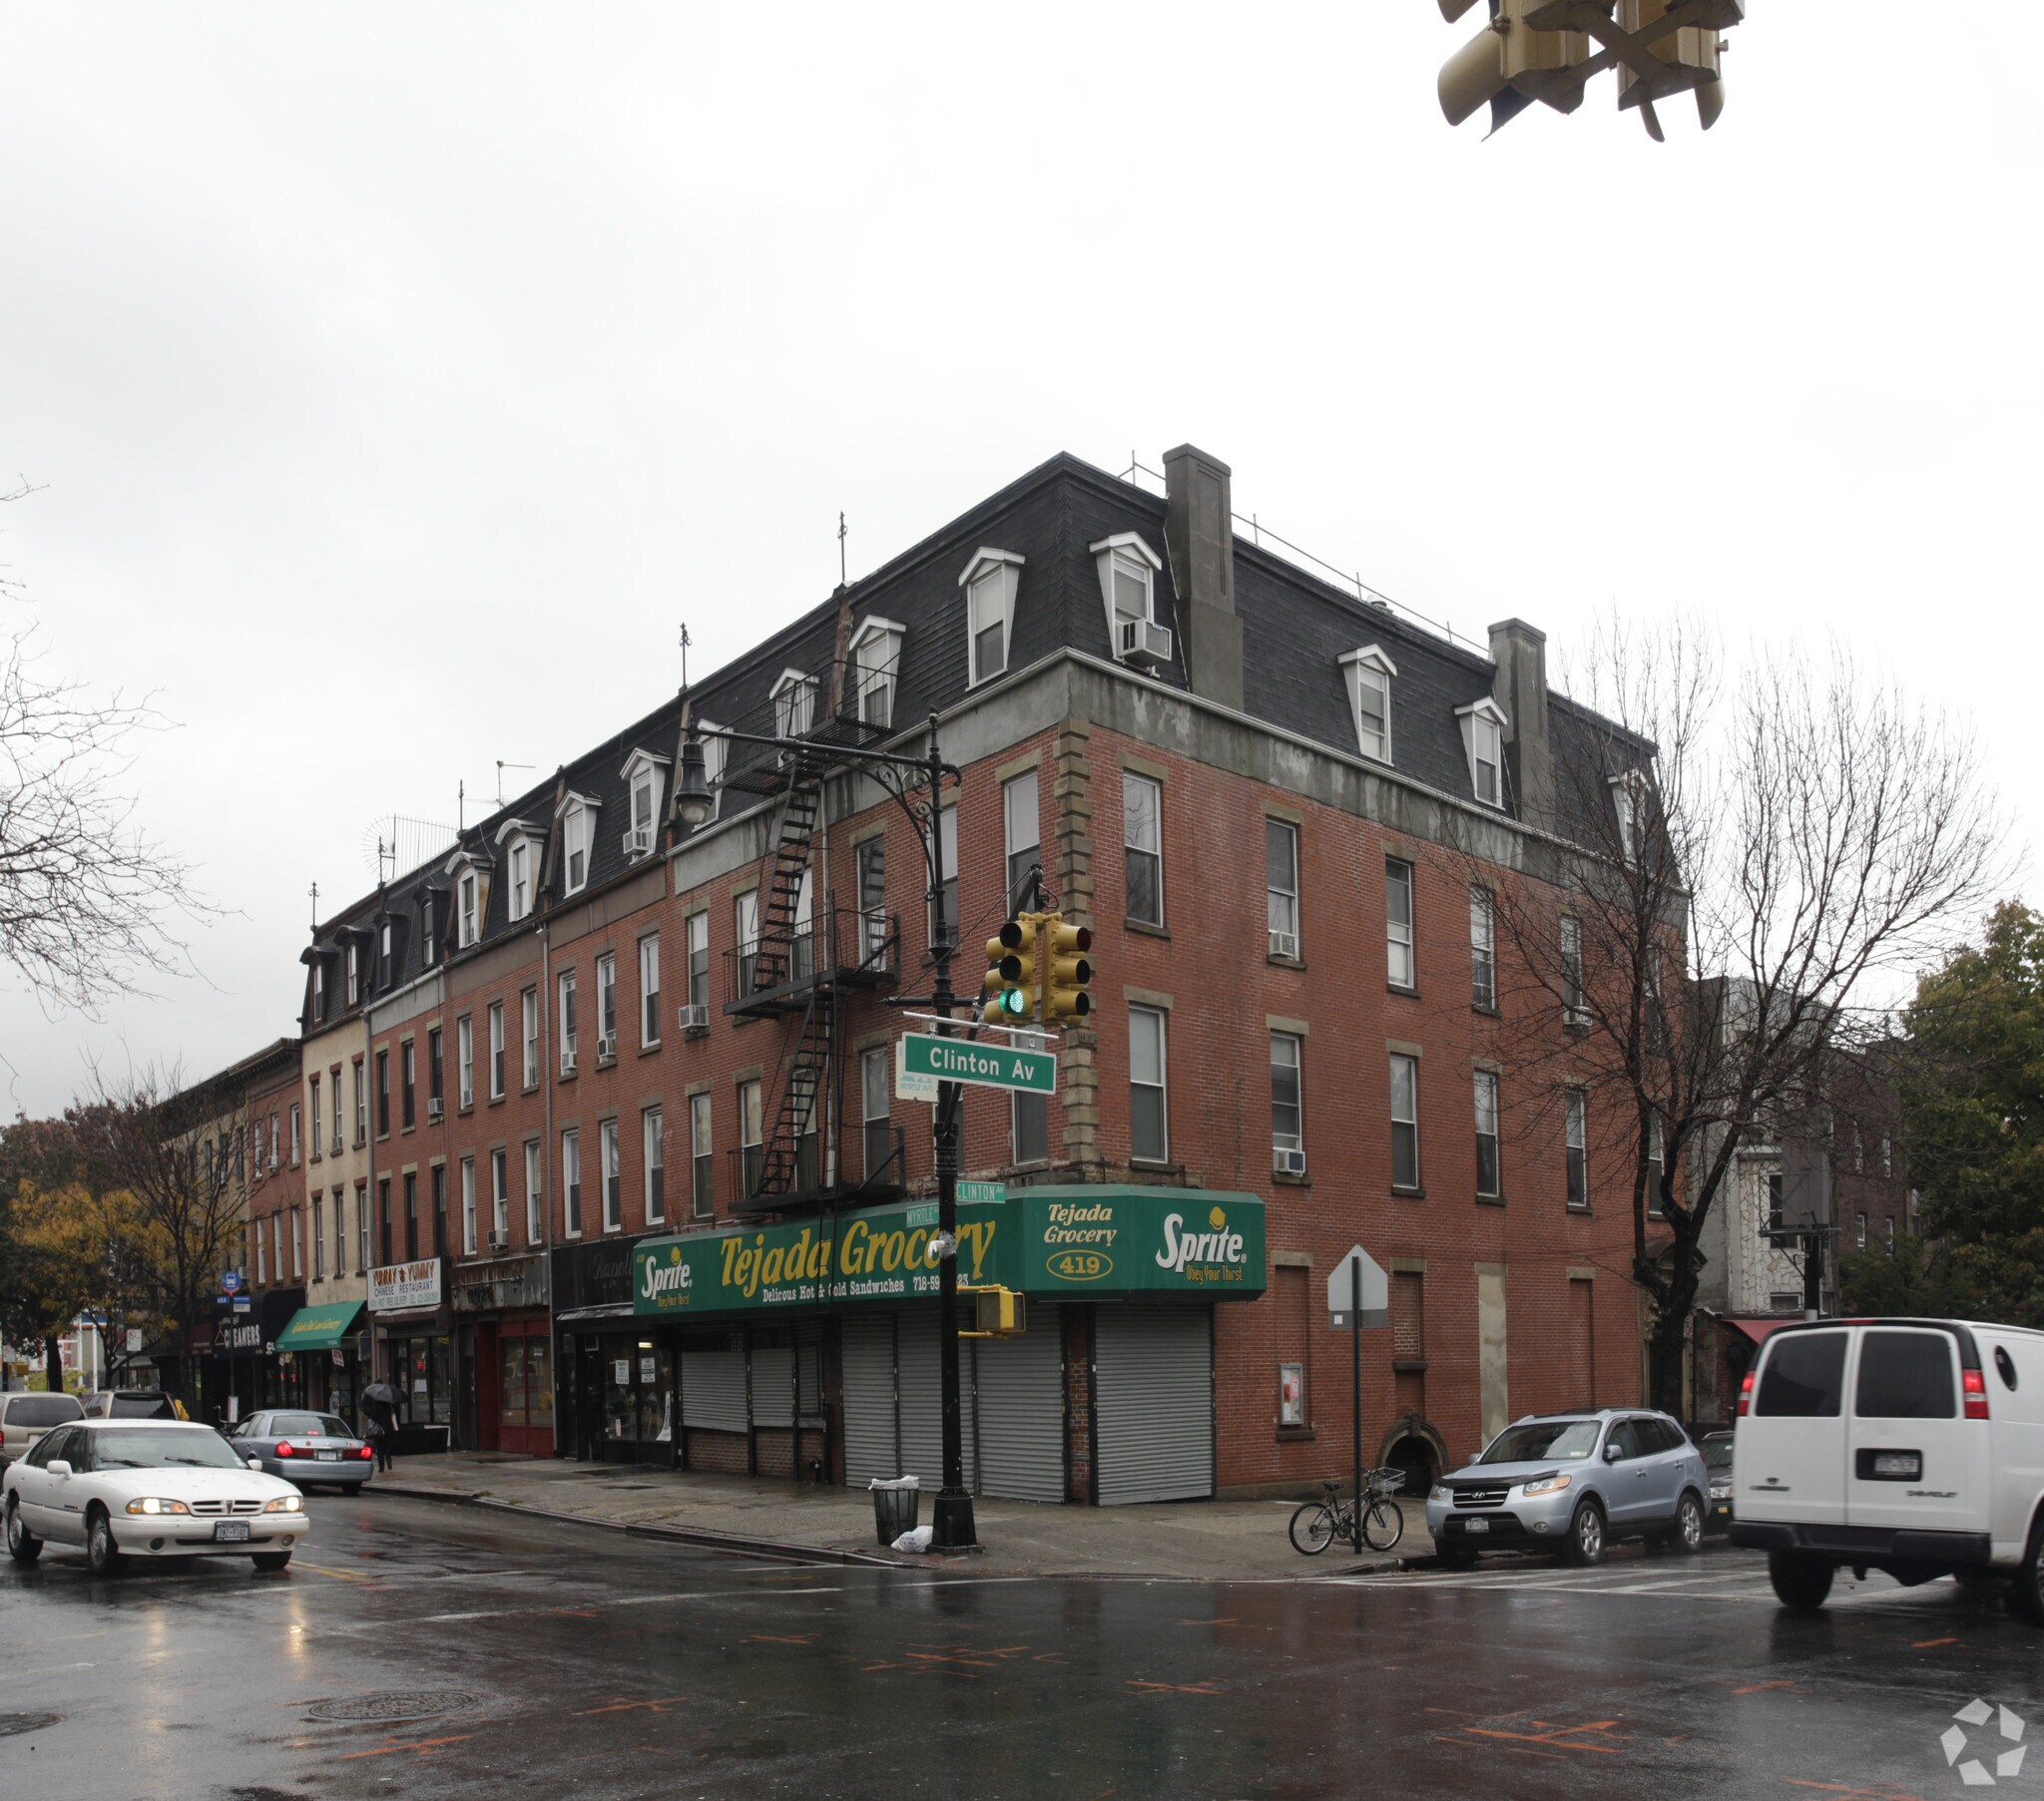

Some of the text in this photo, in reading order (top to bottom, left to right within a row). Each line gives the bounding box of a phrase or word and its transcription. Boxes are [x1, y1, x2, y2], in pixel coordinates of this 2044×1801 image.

[929, 1047, 1035, 1081] Clinton Av
[956, 1183, 995, 1200] CLINTON
[906, 1206, 933, 1223] MYRTLE
[1048, 1203, 1113, 1226] Tejada
[1044, 1225, 1117, 1247] Grocery
[1155, 1213, 1244, 1273] Sprite
[372, 1260, 435, 1288] YUMMY YUMMY
[720, 1227, 831, 1298] Tejada
[1059, 1255, 1101, 1275] 419
[641, 1255, 691, 1301] Sprite
[1186, 1264, 1243, 1285] Obey Your Thirst
[374, 1280, 433, 1298] CHINESE RESTAURANT
[763, 1287, 796, 1303] Delicous
[799, 1285, 815, 1300] Hot
[850, 1279, 904, 1296] Sandwiches
